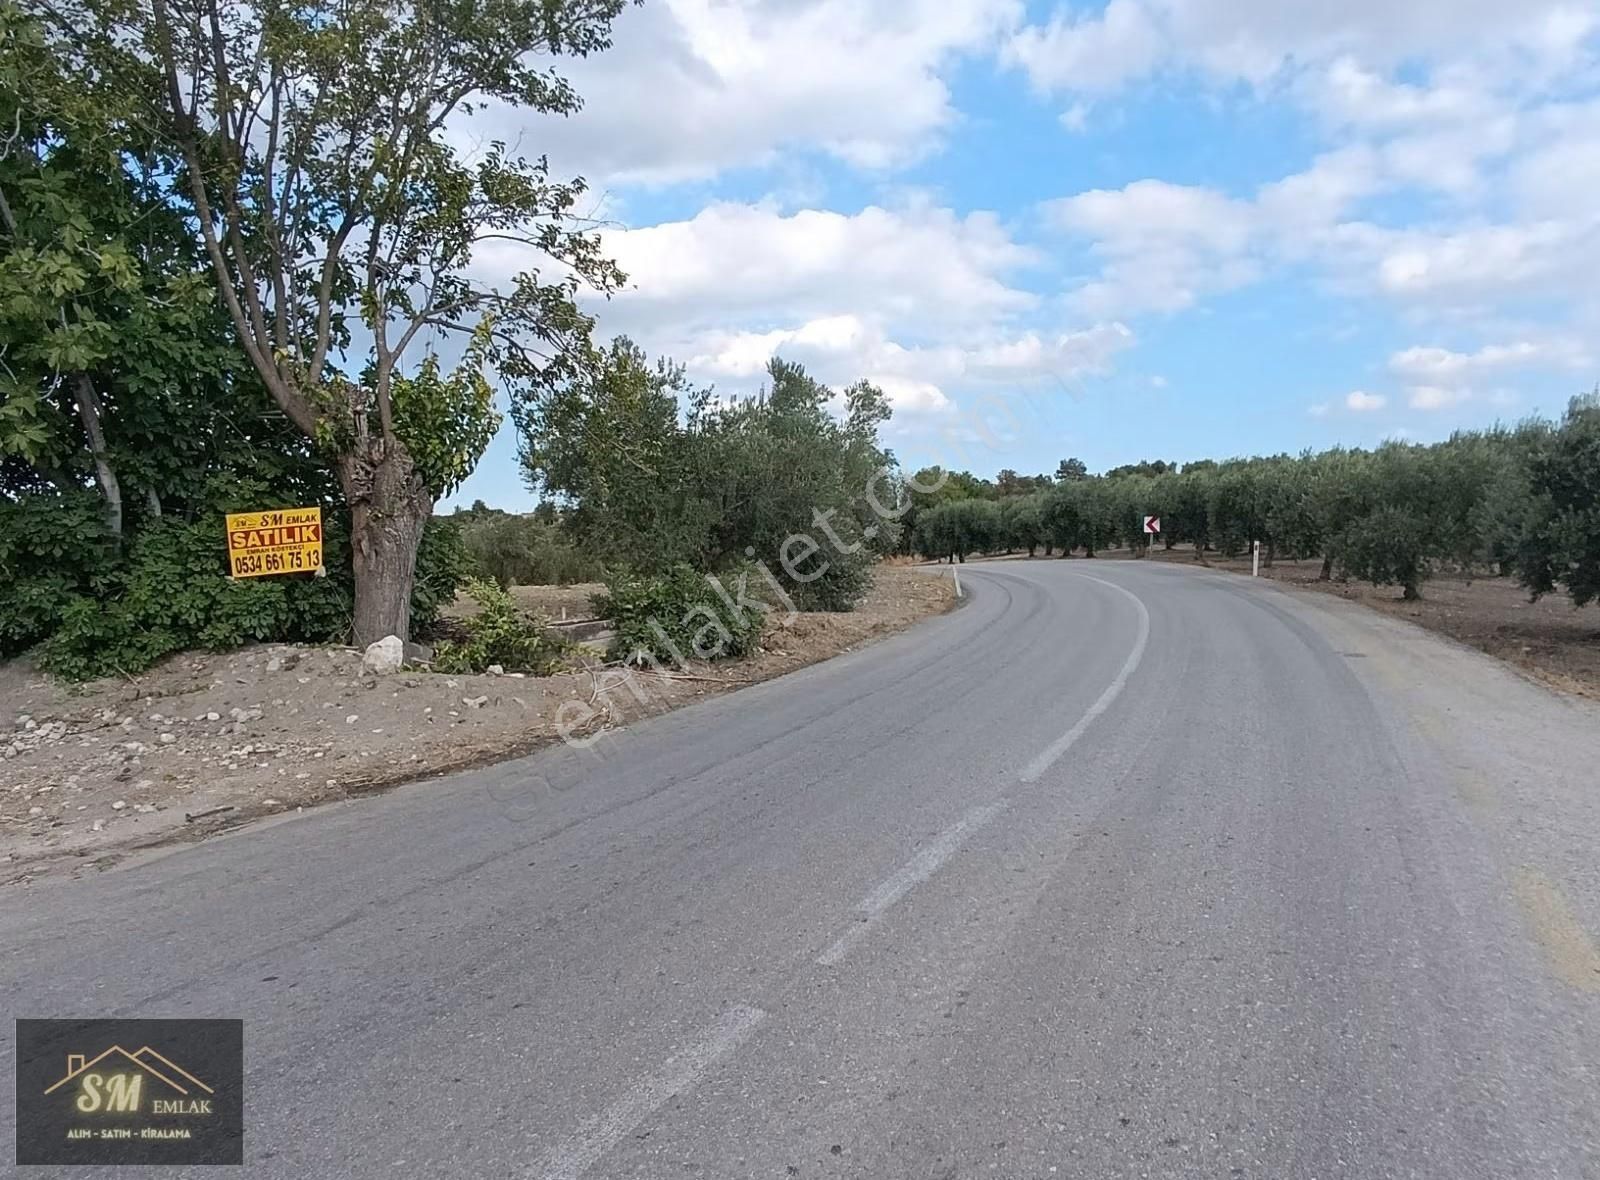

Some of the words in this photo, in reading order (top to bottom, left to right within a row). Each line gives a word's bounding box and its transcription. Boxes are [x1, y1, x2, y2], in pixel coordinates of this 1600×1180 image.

[260, 514, 283, 527] SM
[286, 514, 317, 525] EMLAK
[232, 525, 318, 548] SATILIK
[246, 547, 270, 555] EMRAH
[235, 555, 262, 574] 0534
[265, 553, 285, 571] 661
[288, 551, 302, 569] 75
[306, 549, 320, 567] 13
